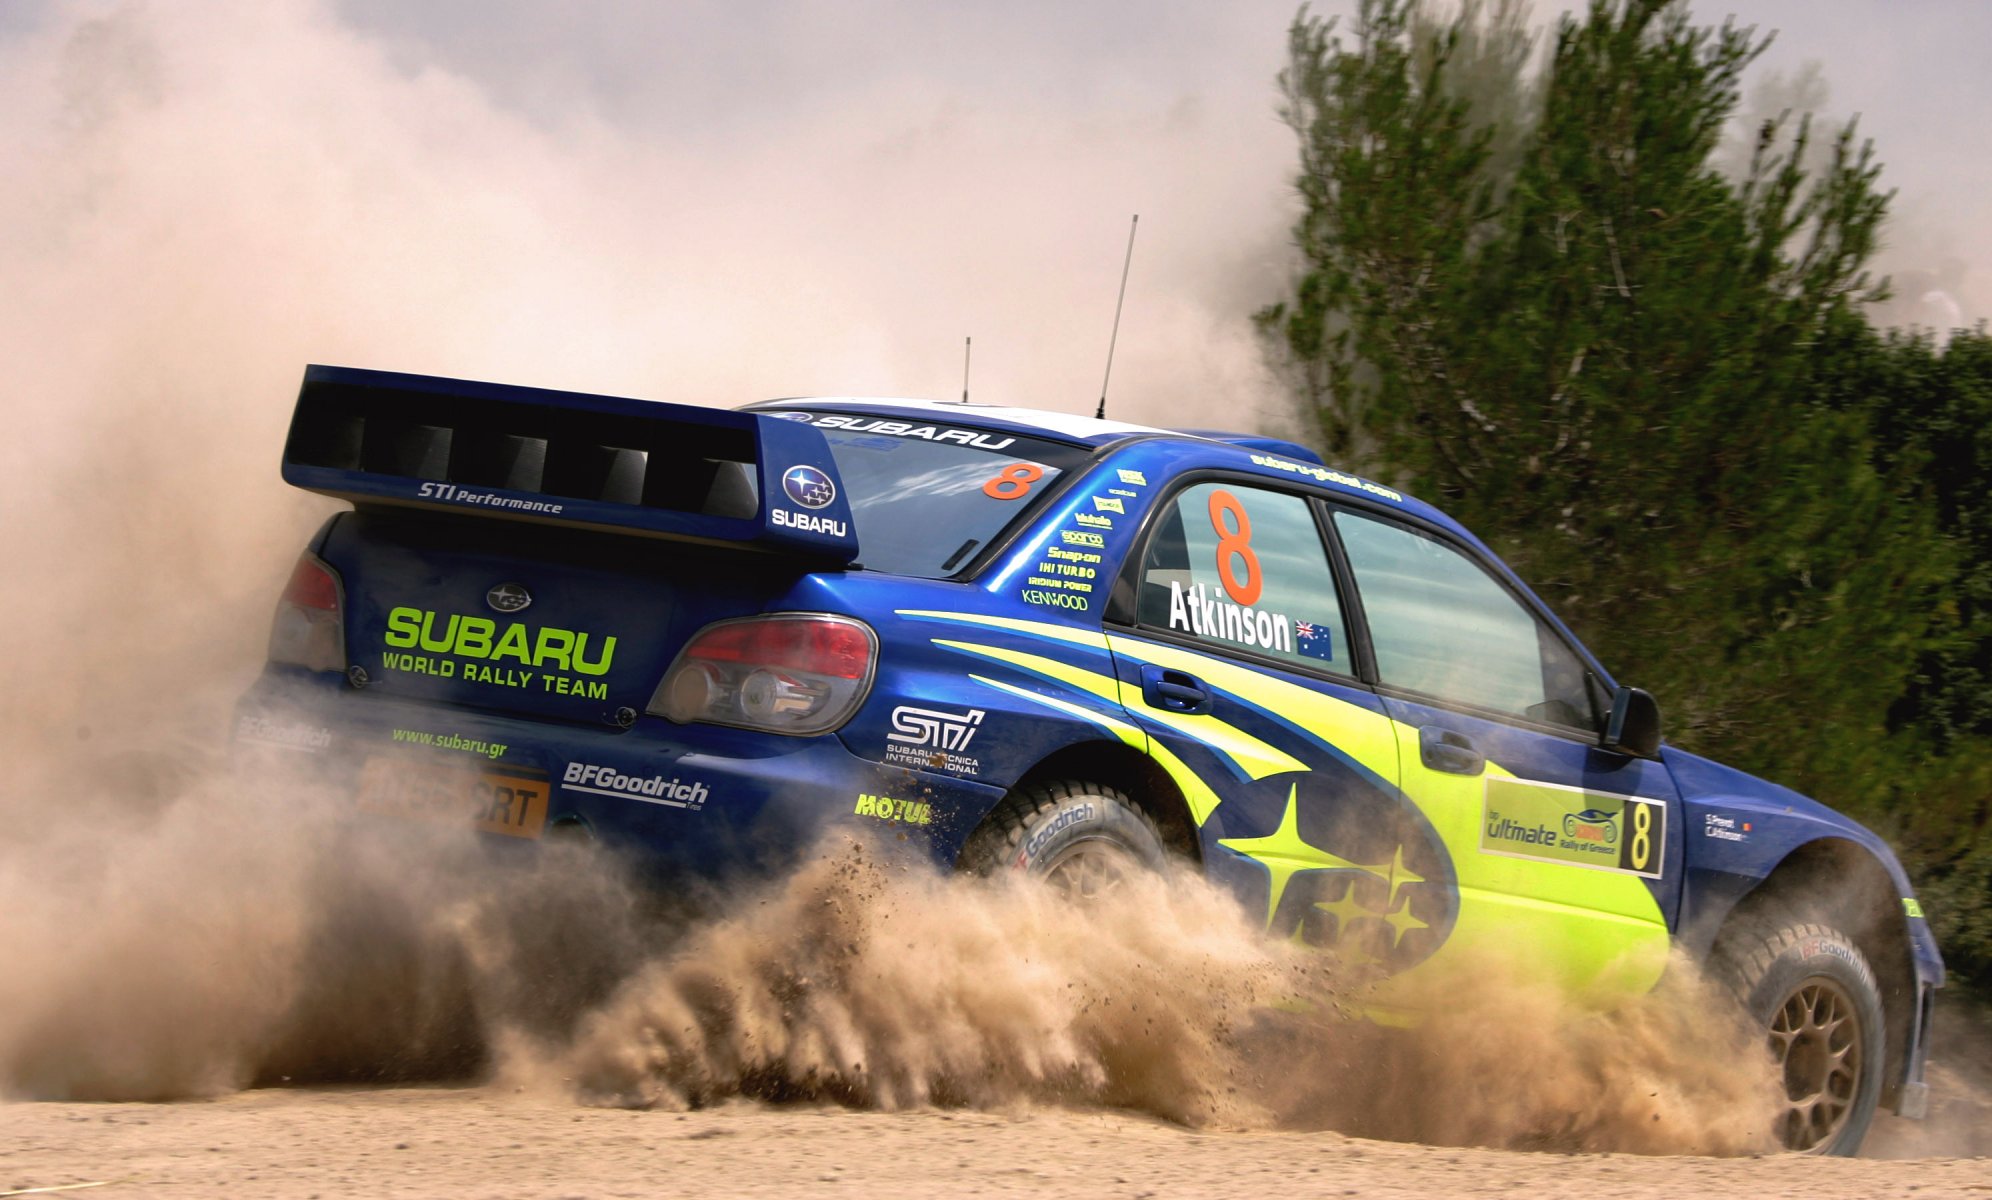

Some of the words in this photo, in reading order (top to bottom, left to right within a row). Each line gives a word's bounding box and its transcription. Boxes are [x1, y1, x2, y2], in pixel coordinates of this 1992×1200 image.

[812, 416, 1016, 450] SUBARU
[982, 463, 1044, 500] 8
[418, 482, 456, 500] STI
[456, 490, 563, 514] Performance
[772, 508, 846, 537] SUBARU
[1047, 546, 1101, 564] Snap-on
[1208, 489, 1263, 606] 8
[1039, 562, 1055, 574] IHI
[1057, 564, 1096, 579] TURBO
[1021, 589, 1089, 611] KENWOOD
[1169, 580, 1291, 653] Atkinson
[385, 606, 617, 676] SUBARU
[382, 651, 455, 678] WORLD
[463, 663, 533, 689] RALLY
[542, 674, 608, 701] TEAM
[392, 728, 507, 759] www.subaru.gr
[887, 744, 933, 758] SUBARU
[886, 752, 978, 775] INTERNIONAL
[563, 762, 709, 804] BFGoodrich
[854, 793, 933, 825] MOTUL
[1487, 817, 1558, 847] ultimate
[1559, 838, 1579, 853] Rally
[1580, 841, 1590, 852] of
[1588, 843, 1616, 856] Greece
[1631, 801, 1651, 871] 8
